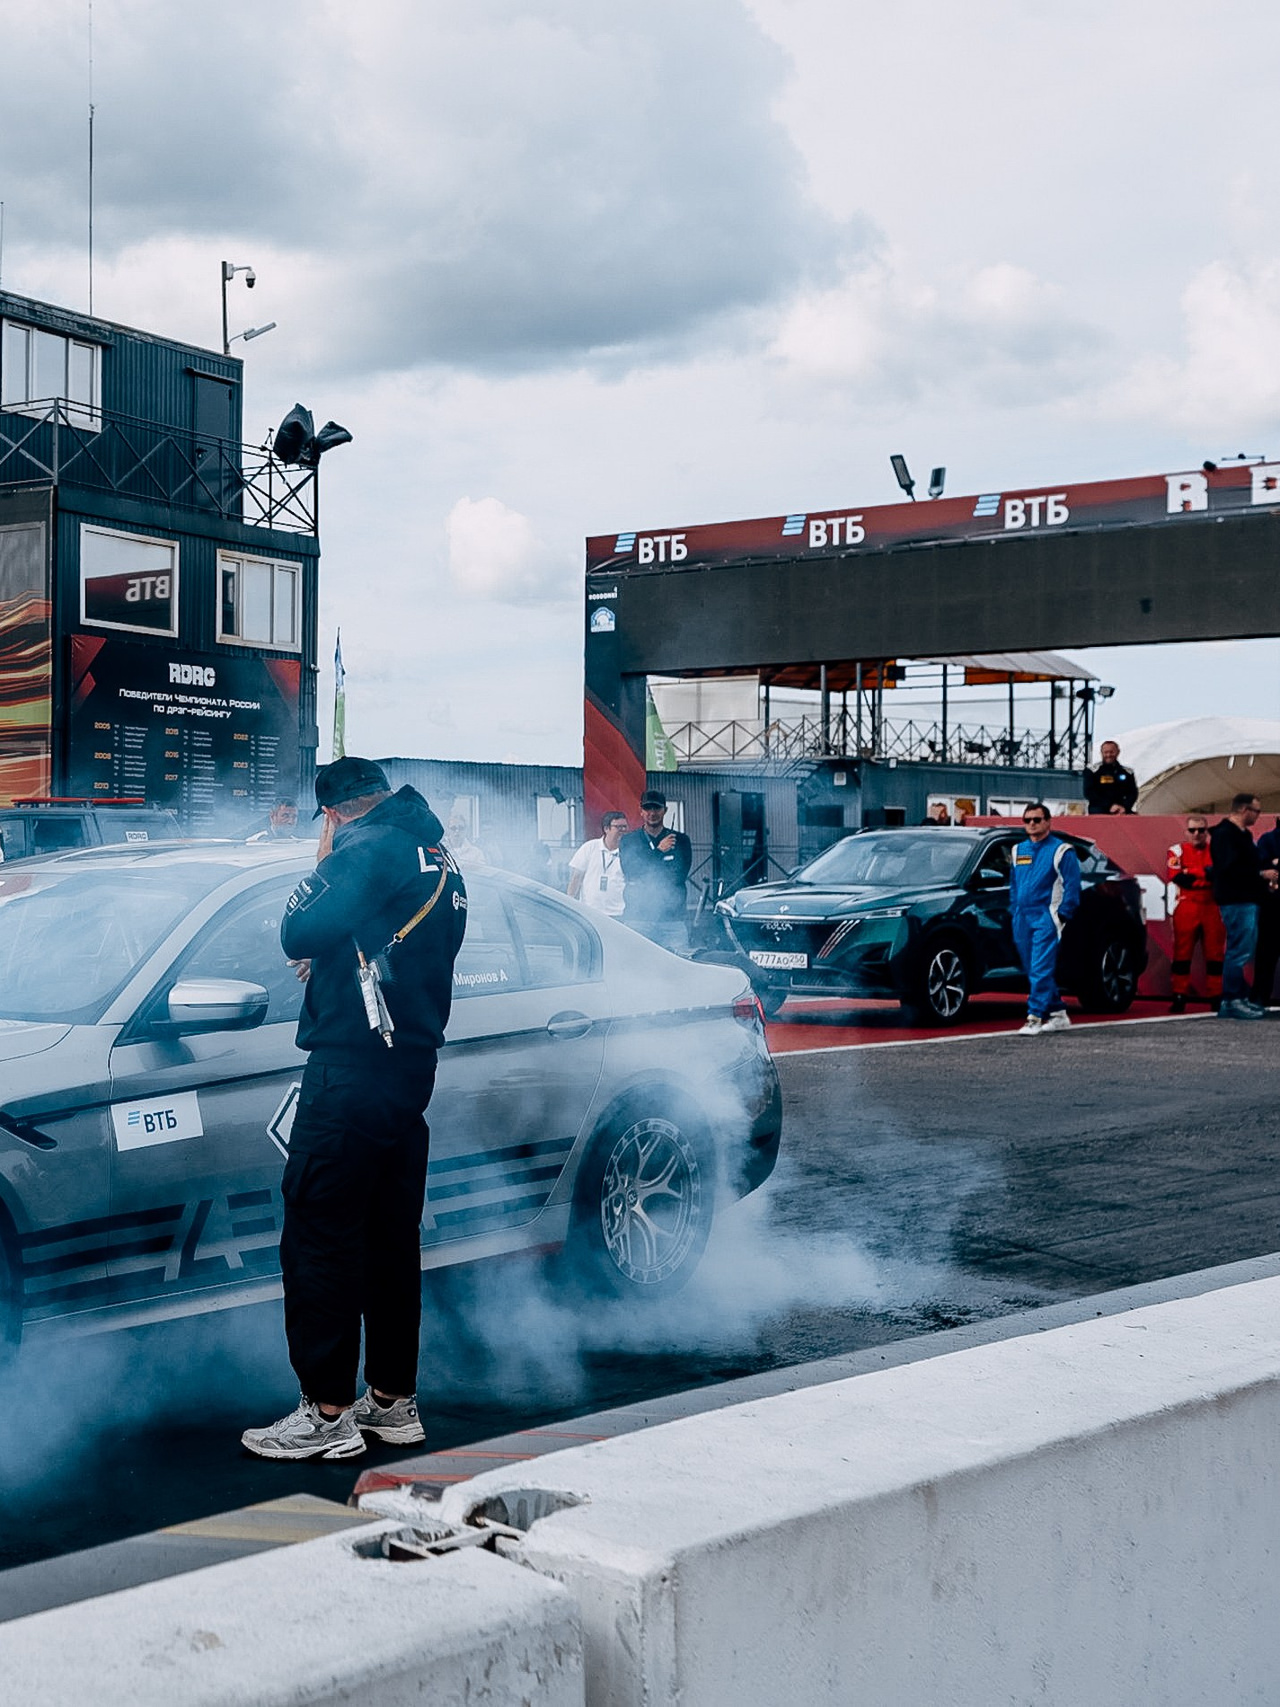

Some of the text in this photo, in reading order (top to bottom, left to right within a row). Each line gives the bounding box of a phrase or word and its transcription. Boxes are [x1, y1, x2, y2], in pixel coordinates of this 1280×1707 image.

[1004, 493, 1070, 530] ВТБ
[808, 514, 866, 549] ВТБ
[637, 533, 688, 565] ВТБ
[168, 662, 216, 687] RDRC
[452, 972, 499, 988] Миронов
[143, 1109, 178, 1134] ВТБ
